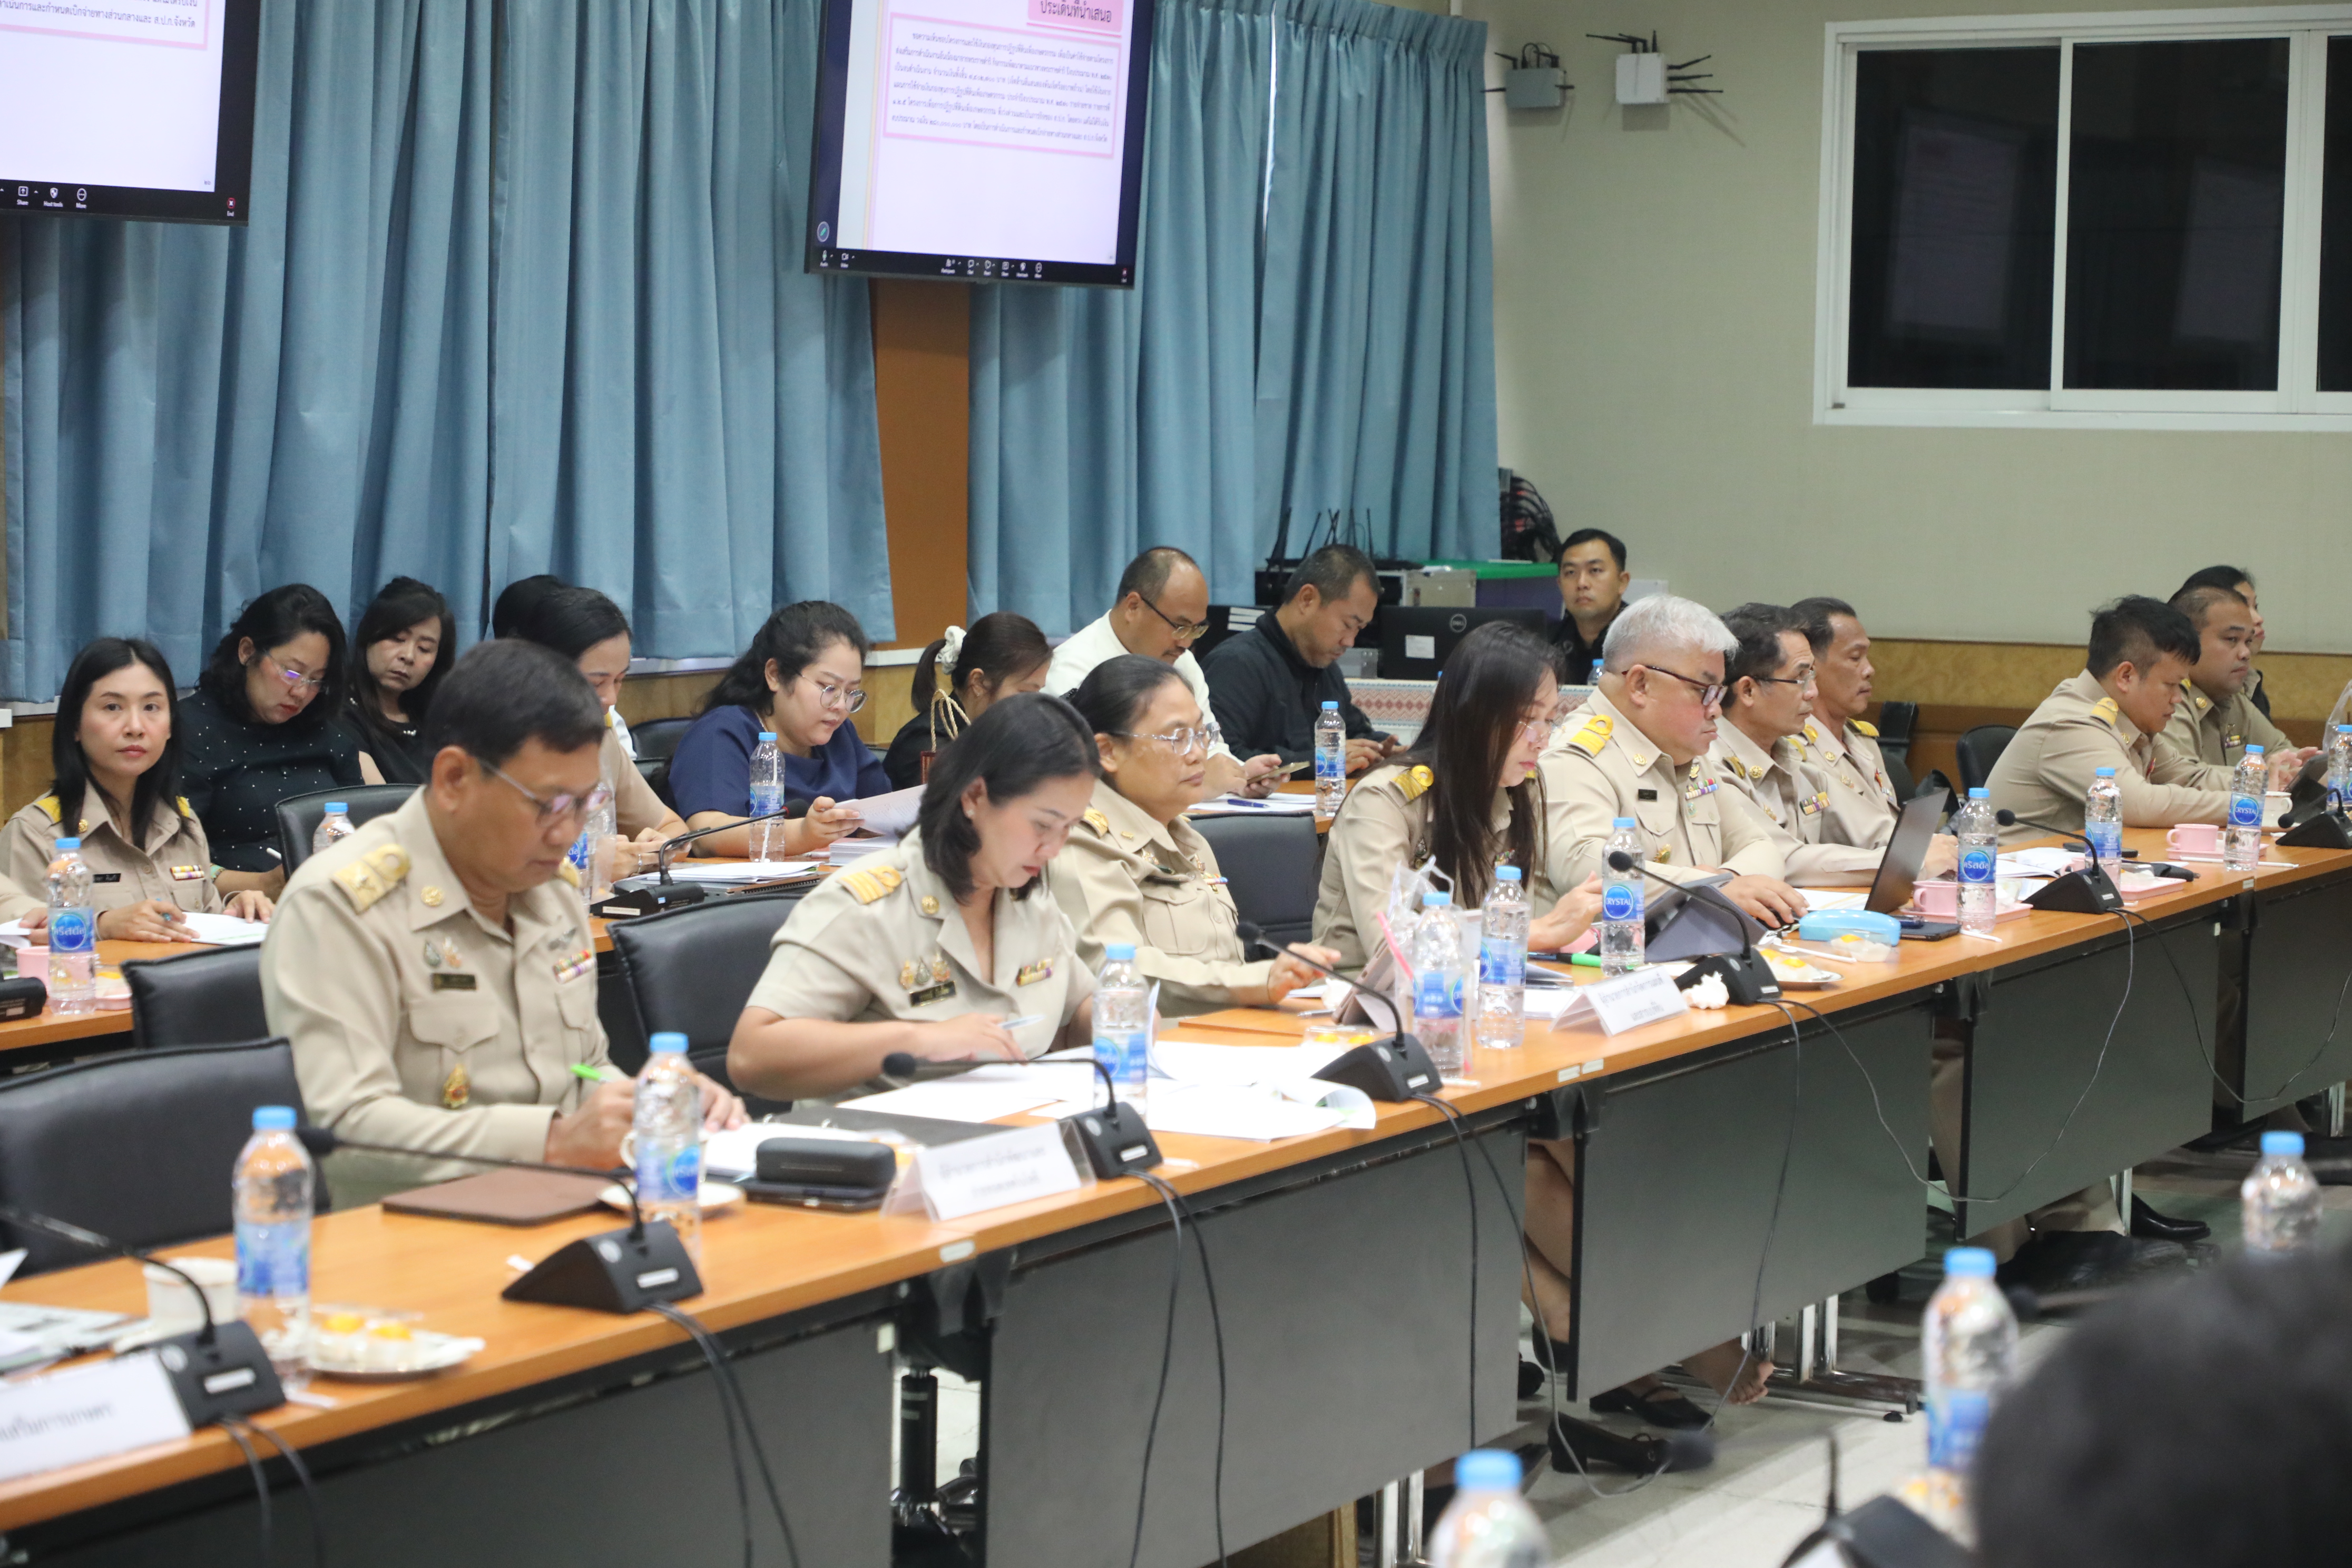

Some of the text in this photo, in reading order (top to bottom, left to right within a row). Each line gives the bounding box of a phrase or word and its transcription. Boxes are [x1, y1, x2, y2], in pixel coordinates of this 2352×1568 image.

[1041, 0, 1112, 22] ประเดนทีนำเสนอ
